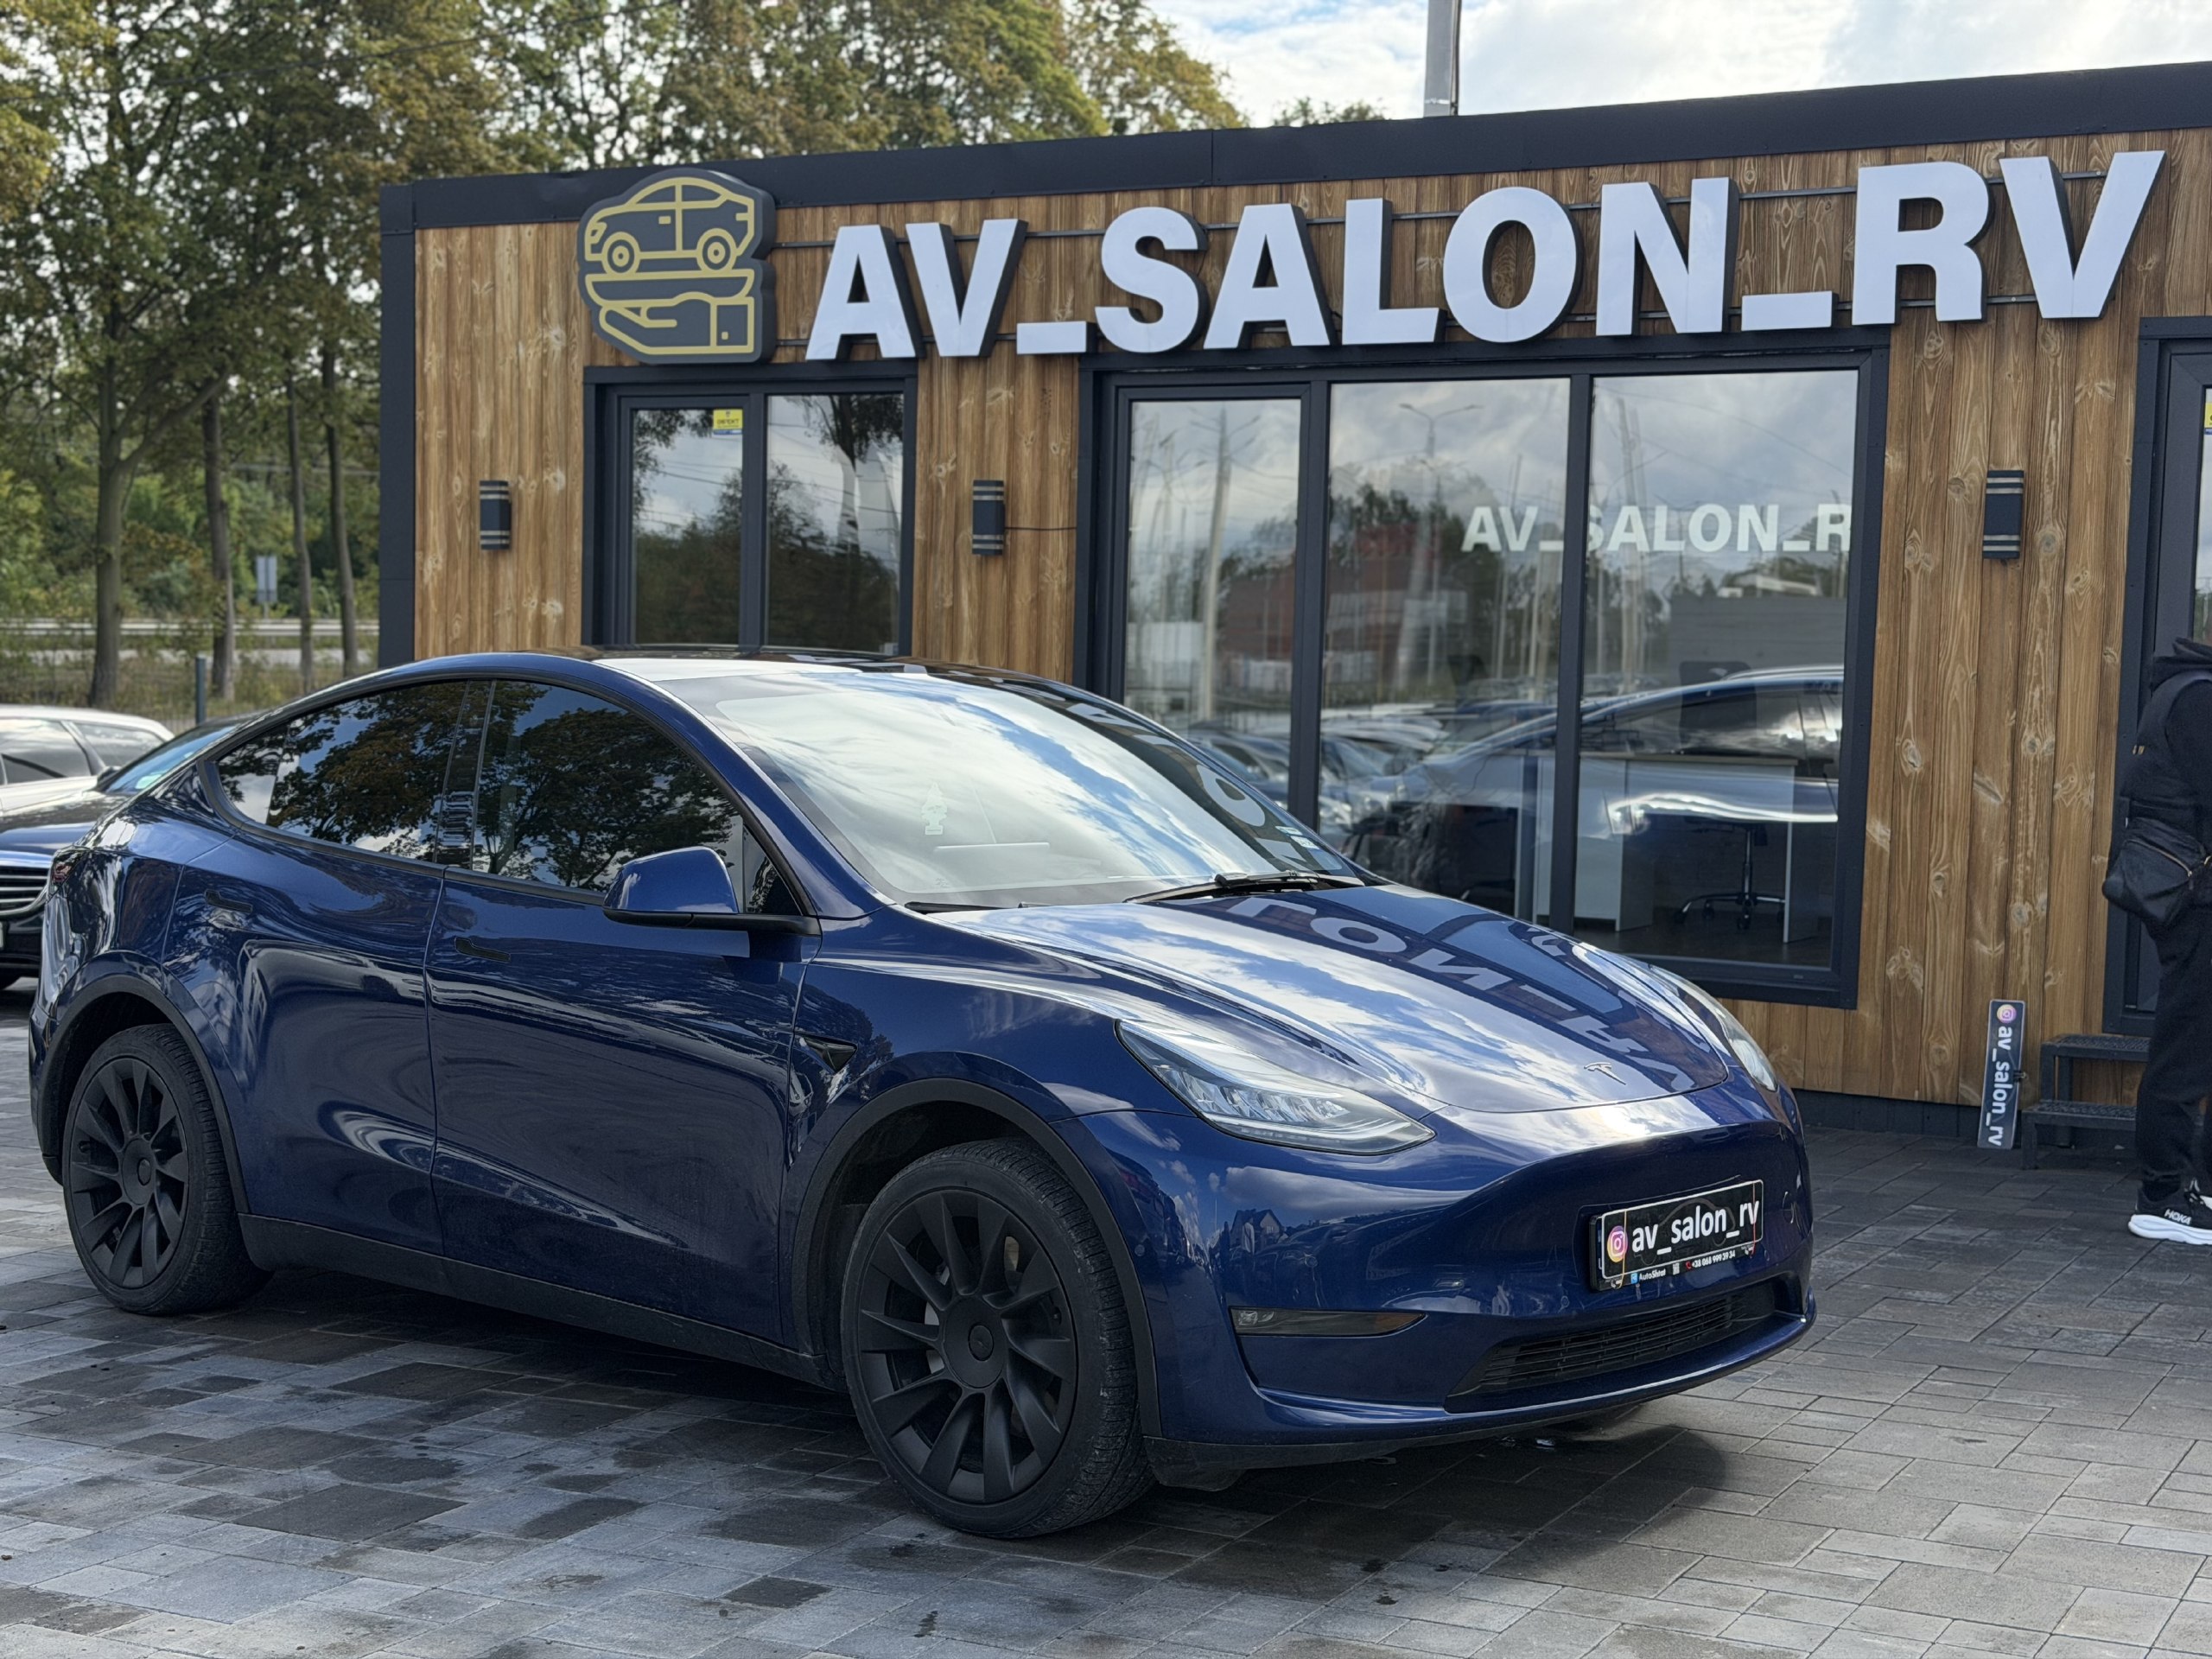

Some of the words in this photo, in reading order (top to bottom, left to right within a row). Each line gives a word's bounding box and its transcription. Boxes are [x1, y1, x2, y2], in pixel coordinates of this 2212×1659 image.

[805, 150, 2165, 361] AV_SALON_RV
[1986, 1026, 2013, 1147] av_salon_rv
[1631, 1200, 1759, 1255] av_salon_rv
[2164, 1208, 2192, 1225] HOKA
